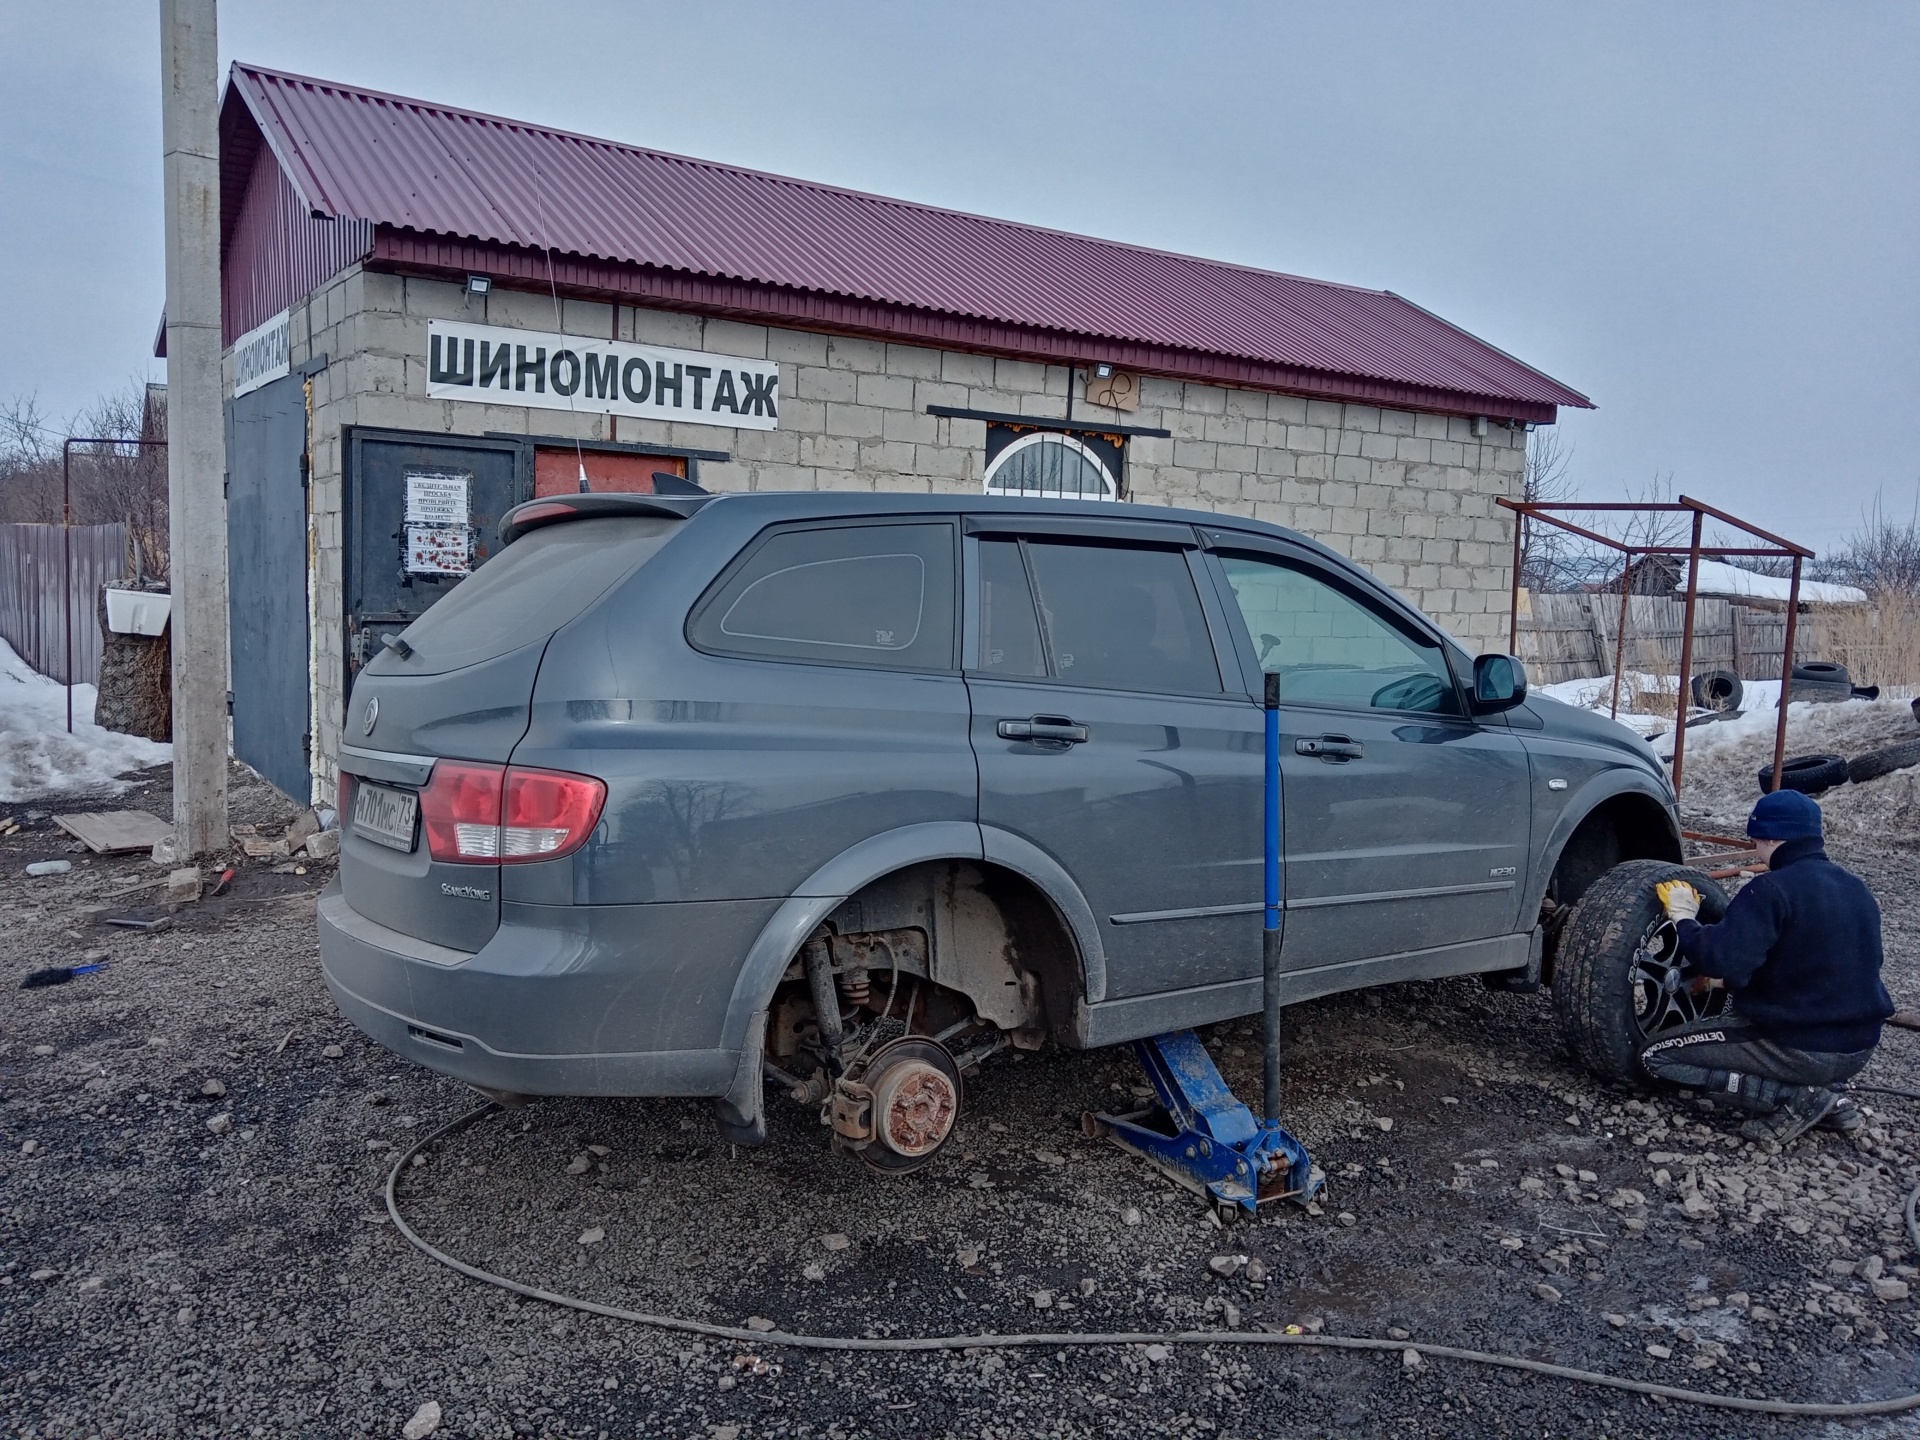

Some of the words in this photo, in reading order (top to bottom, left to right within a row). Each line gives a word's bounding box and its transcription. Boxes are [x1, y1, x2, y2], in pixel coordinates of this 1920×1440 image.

[235, 321, 290, 388] ШИНОМОНТАЖ
[430, 334, 778, 418] ШИНОМОНТАЖ
[423, 490, 452, 498] ПРОСЬБА
[420, 506, 454, 514] ПРОТЯЖКУ
[399, 796, 413, 825] 73
[1490, 866, 1516, 878] M230
